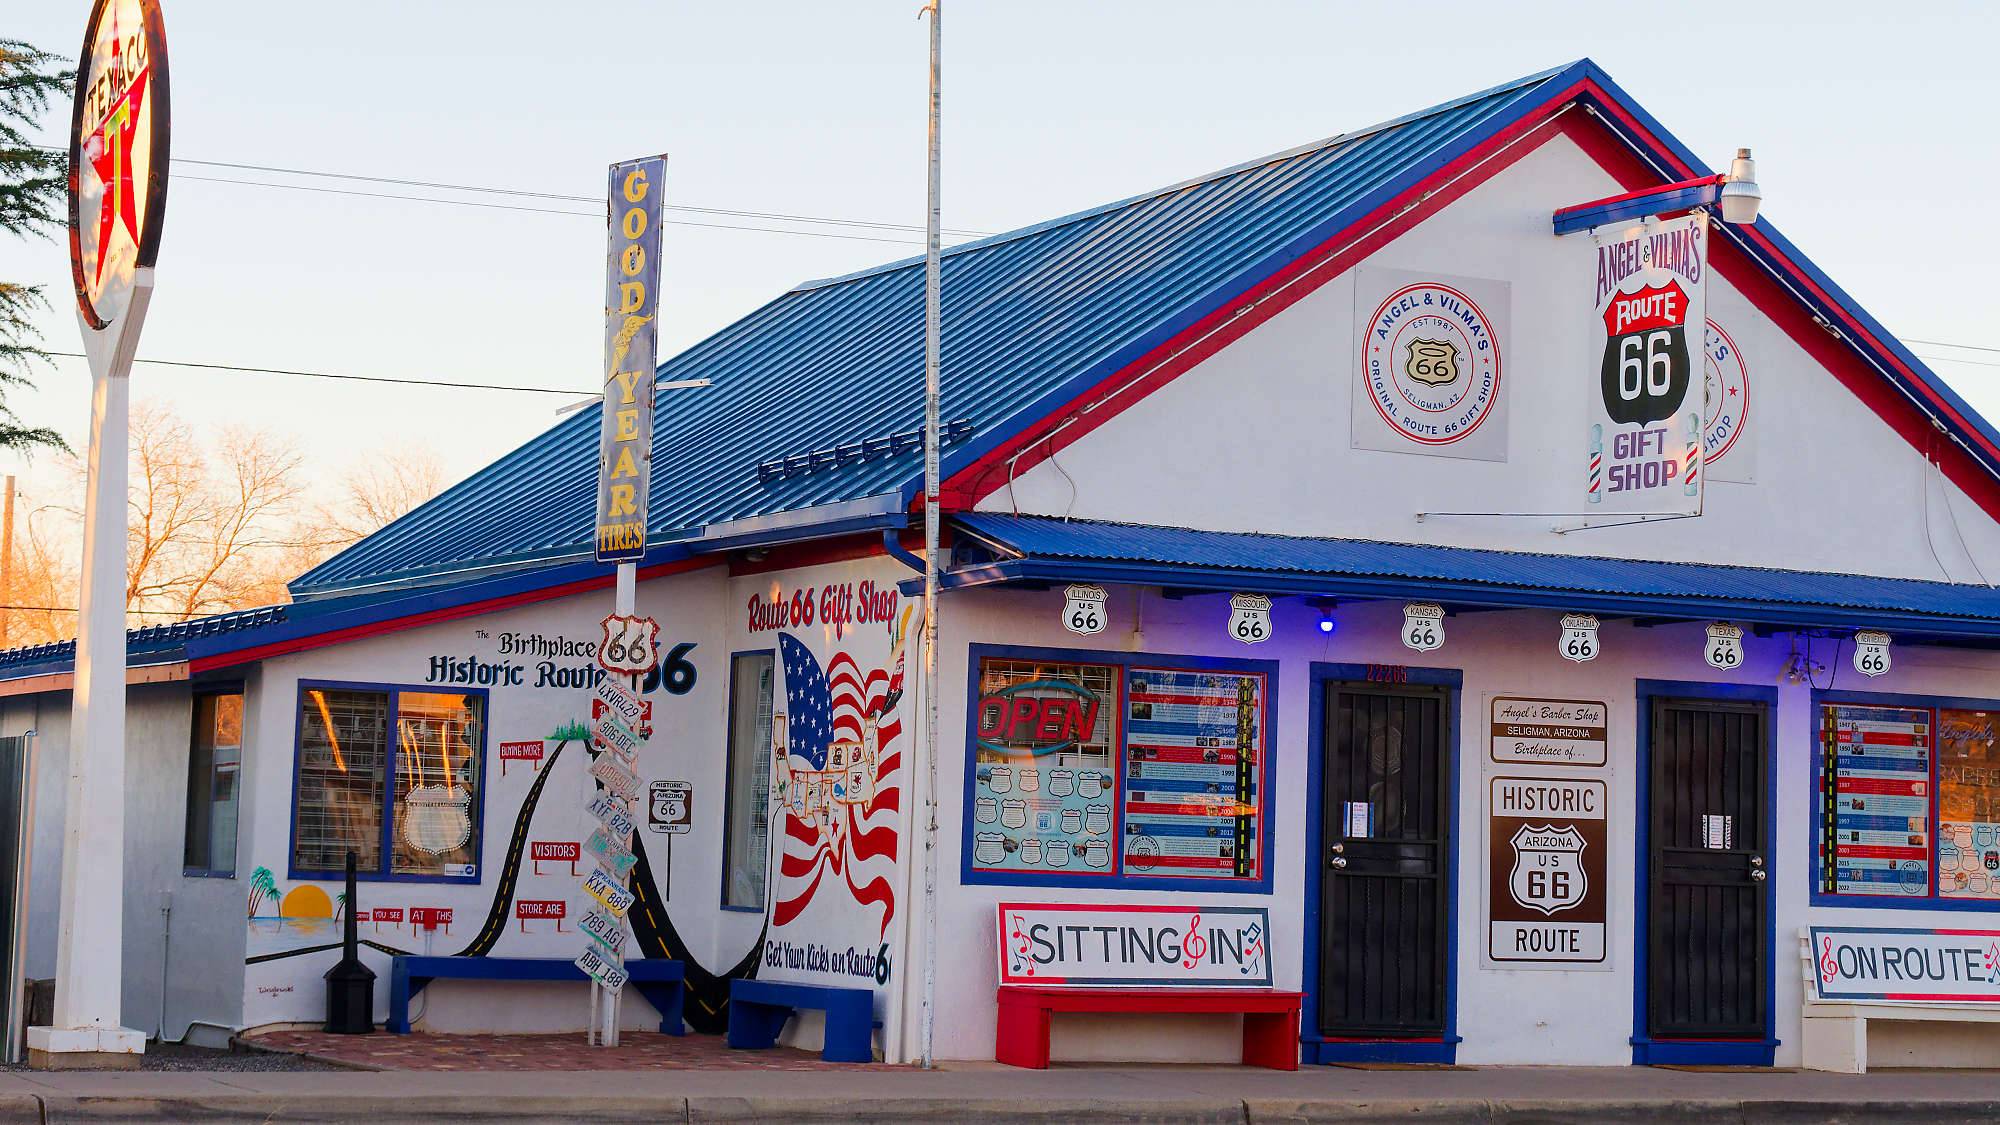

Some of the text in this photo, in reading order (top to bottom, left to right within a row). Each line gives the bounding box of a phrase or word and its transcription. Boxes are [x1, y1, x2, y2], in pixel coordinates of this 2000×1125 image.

[88, 23, 147, 132] TEXACO
[1595, 221, 1701, 310] ANGEL & VILMA'S
[1377, 293, 1489, 350] ANGEL & VILMA'S
[1616, 291, 1677, 335] ROUTE
[1413, 319, 1454, 332] EST 1987
[608, 169, 650, 517] GOODYEAR
[1416, 359, 1449, 377] 66
[1619, 331, 1671, 401] 66
[1372, 360, 1492, 434] ORIGINAL ROUTE 66 GIFT SHOP
[1450, 393, 1460, 405] AZ
[1613, 428, 1668, 460] GIFT
[1608, 460, 1678, 493] SHOP
[600, 519, 644, 552] TIRES
[1071, 589, 1101, 599] ILLINOIS
[1235, 599, 1267, 608] MISSOURI
[748, 580, 898, 641] Route 66 Gift Shop
[1071, 611, 1099, 629] 66
[1410, 607, 1438, 617] KANSAS
[1237, 620, 1263, 638] 66
[1566, 619, 1595, 628] OKLAHOMA
[1715, 627, 1736, 637] TEXAS
[475, 630, 597, 659] The Birthplace
[1410, 627, 1436, 646] 66
[1873, 635, 1887, 643] MEXICO
[607, 631, 647, 664] 66
[1568, 640, 1592, 656] 66
[1712, 647, 1736, 664] 66
[425, 655, 525, 687] Historic
[1862, 654, 1884, 671] 66
[598, 684, 639, 717] 4XVR429
[977, 697, 1100, 742] OPEN
[1501, 705, 1599, 723] Angel's Barber Shop
[1507, 726, 1590, 738] SELIGMAN, ARIZONA
[501, 743, 541, 757] BUYING MORE
[1515, 742, 1561, 757] Birthplace
[1503, 786, 1594, 812] HISTORIC
[661, 804, 676, 815] 66
[535, 843, 576, 858] VISITORS
[1525, 837, 1573, 847] ARIZONA
[1986, 860, 1998, 868] 66
[586, 876, 628, 910] KXA 889
[1528, 870, 1570, 899] 66
[374, 911, 387, 919] YOU
[390, 911, 400, 919] SEE
[412, 910, 452, 921] AT THIS
[519, 903, 562, 916] STORE ARE
[582, 911, 604, 931] 789
[1029, 923, 1244, 965] SITTING IN
[1516, 928, 1580, 952] ROUTE
[580, 951, 602, 972] ABH
[601, 968, 623, 987] 188
[765, 940, 892, 985] Get Your Kicks on Route 6
[1837, 945, 1986, 982] ON ROUTE
